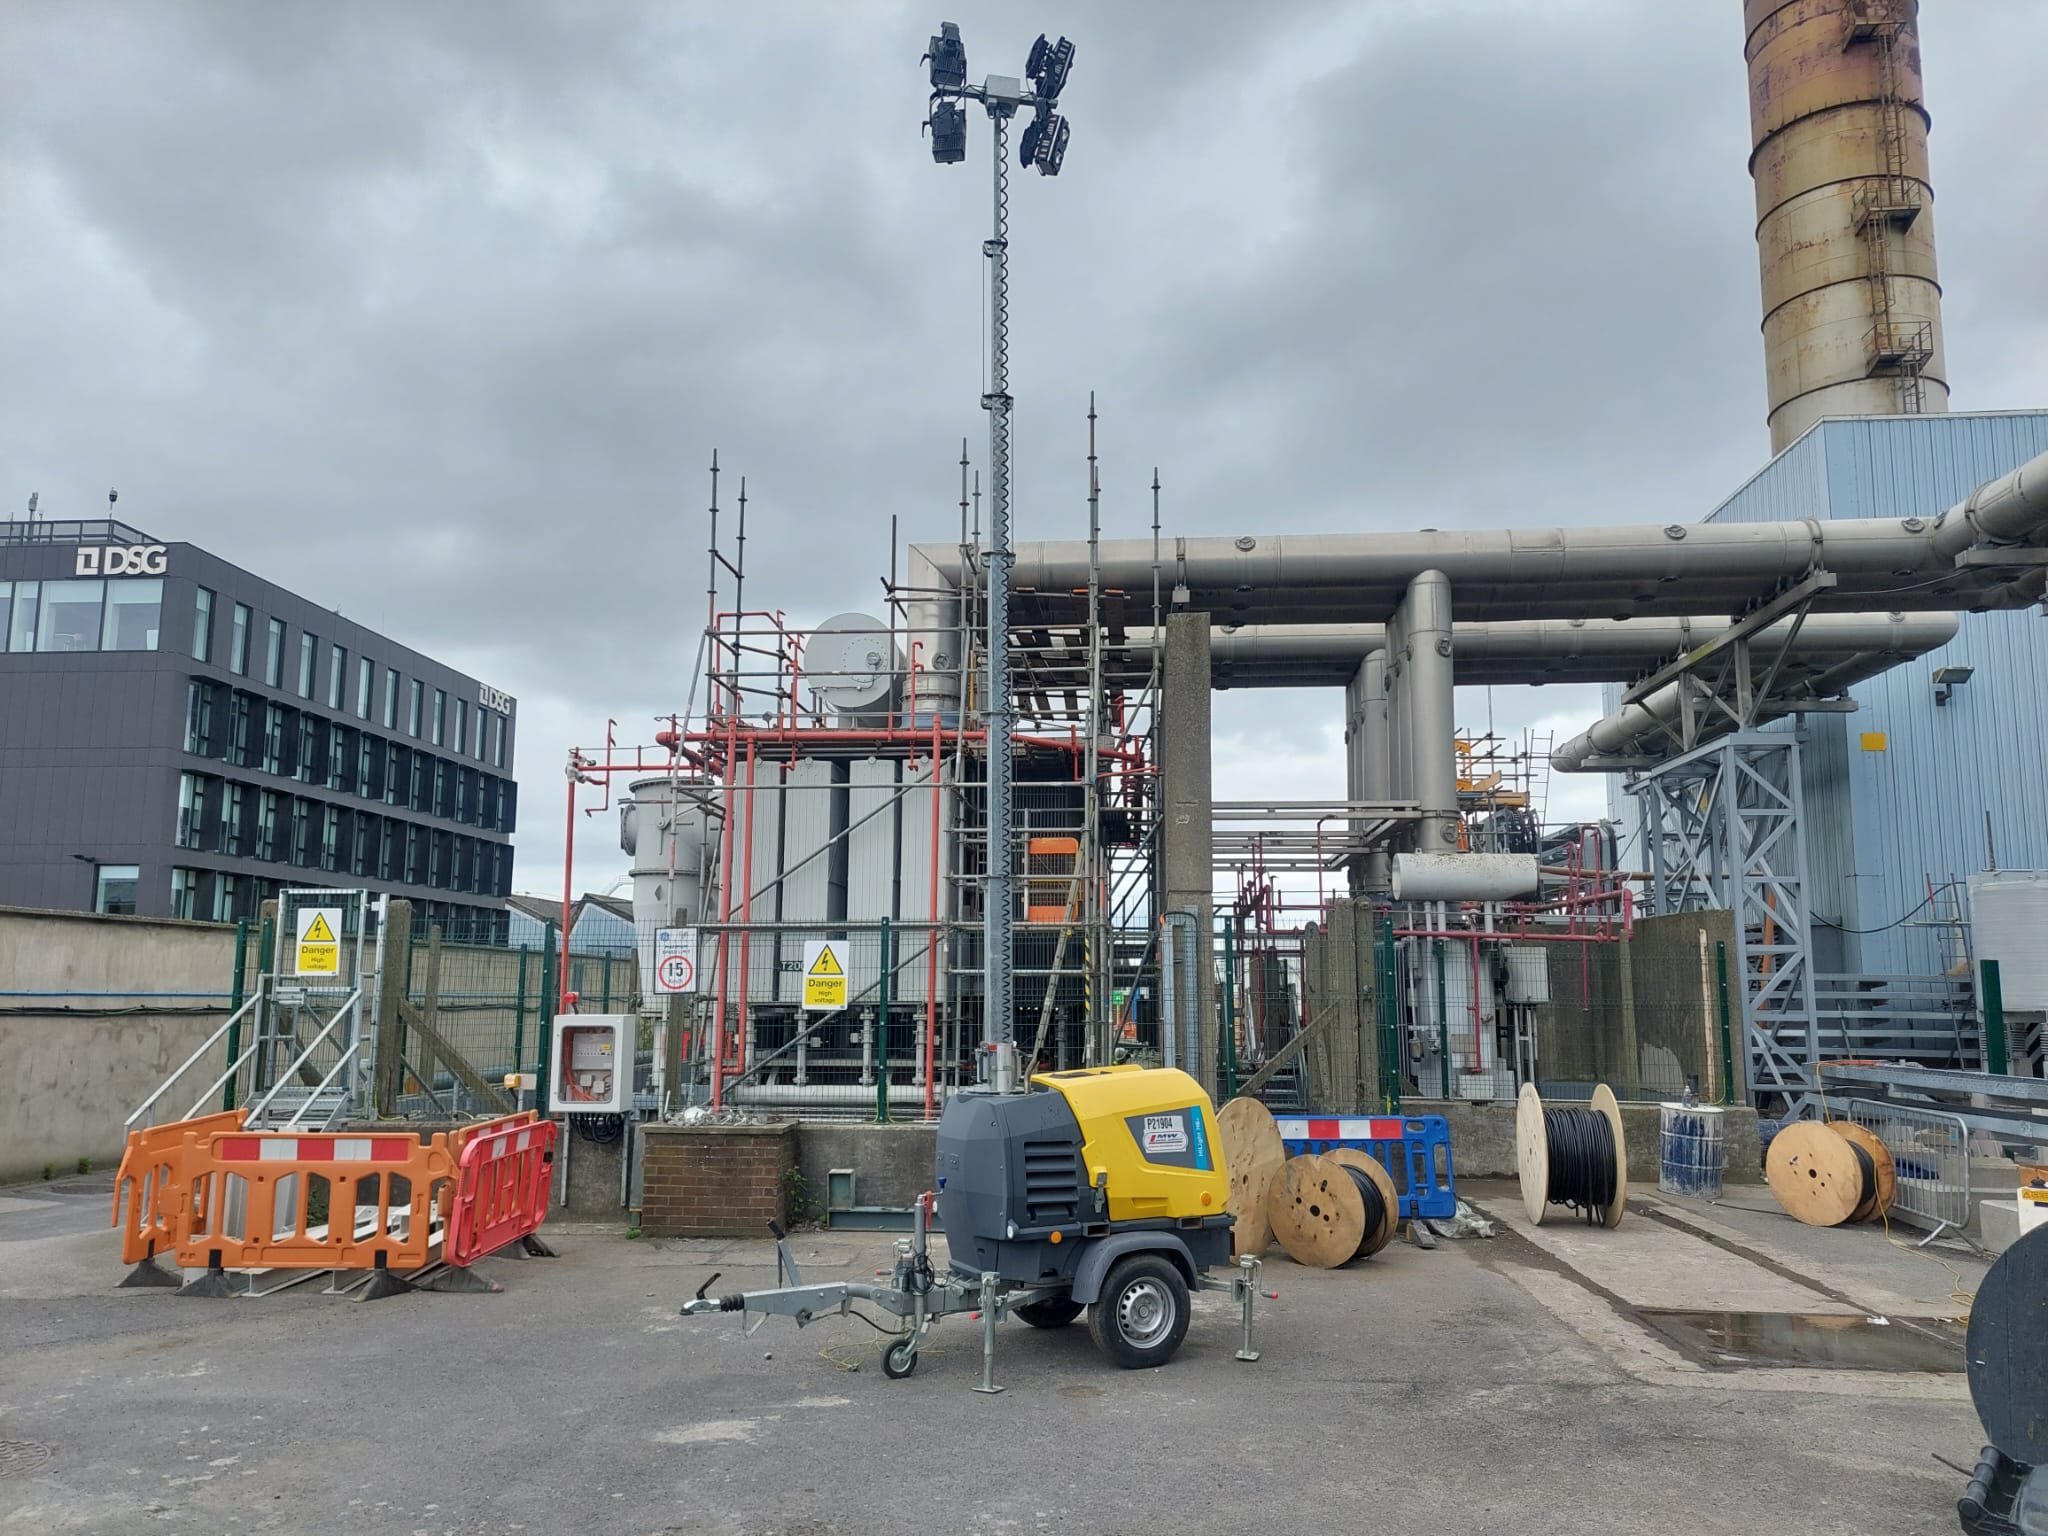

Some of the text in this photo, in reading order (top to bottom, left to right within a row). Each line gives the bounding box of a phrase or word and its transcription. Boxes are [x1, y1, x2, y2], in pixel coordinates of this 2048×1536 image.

[104, 545, 167, 575] DSG
[489, 688, 510, 715] DSG
[301, 946, 335, 955] Danger
[669, 962, 683, 977] 15
[808, 979, 842, 989] Danger
[1147, 1117, 1173, 1130] P21904
